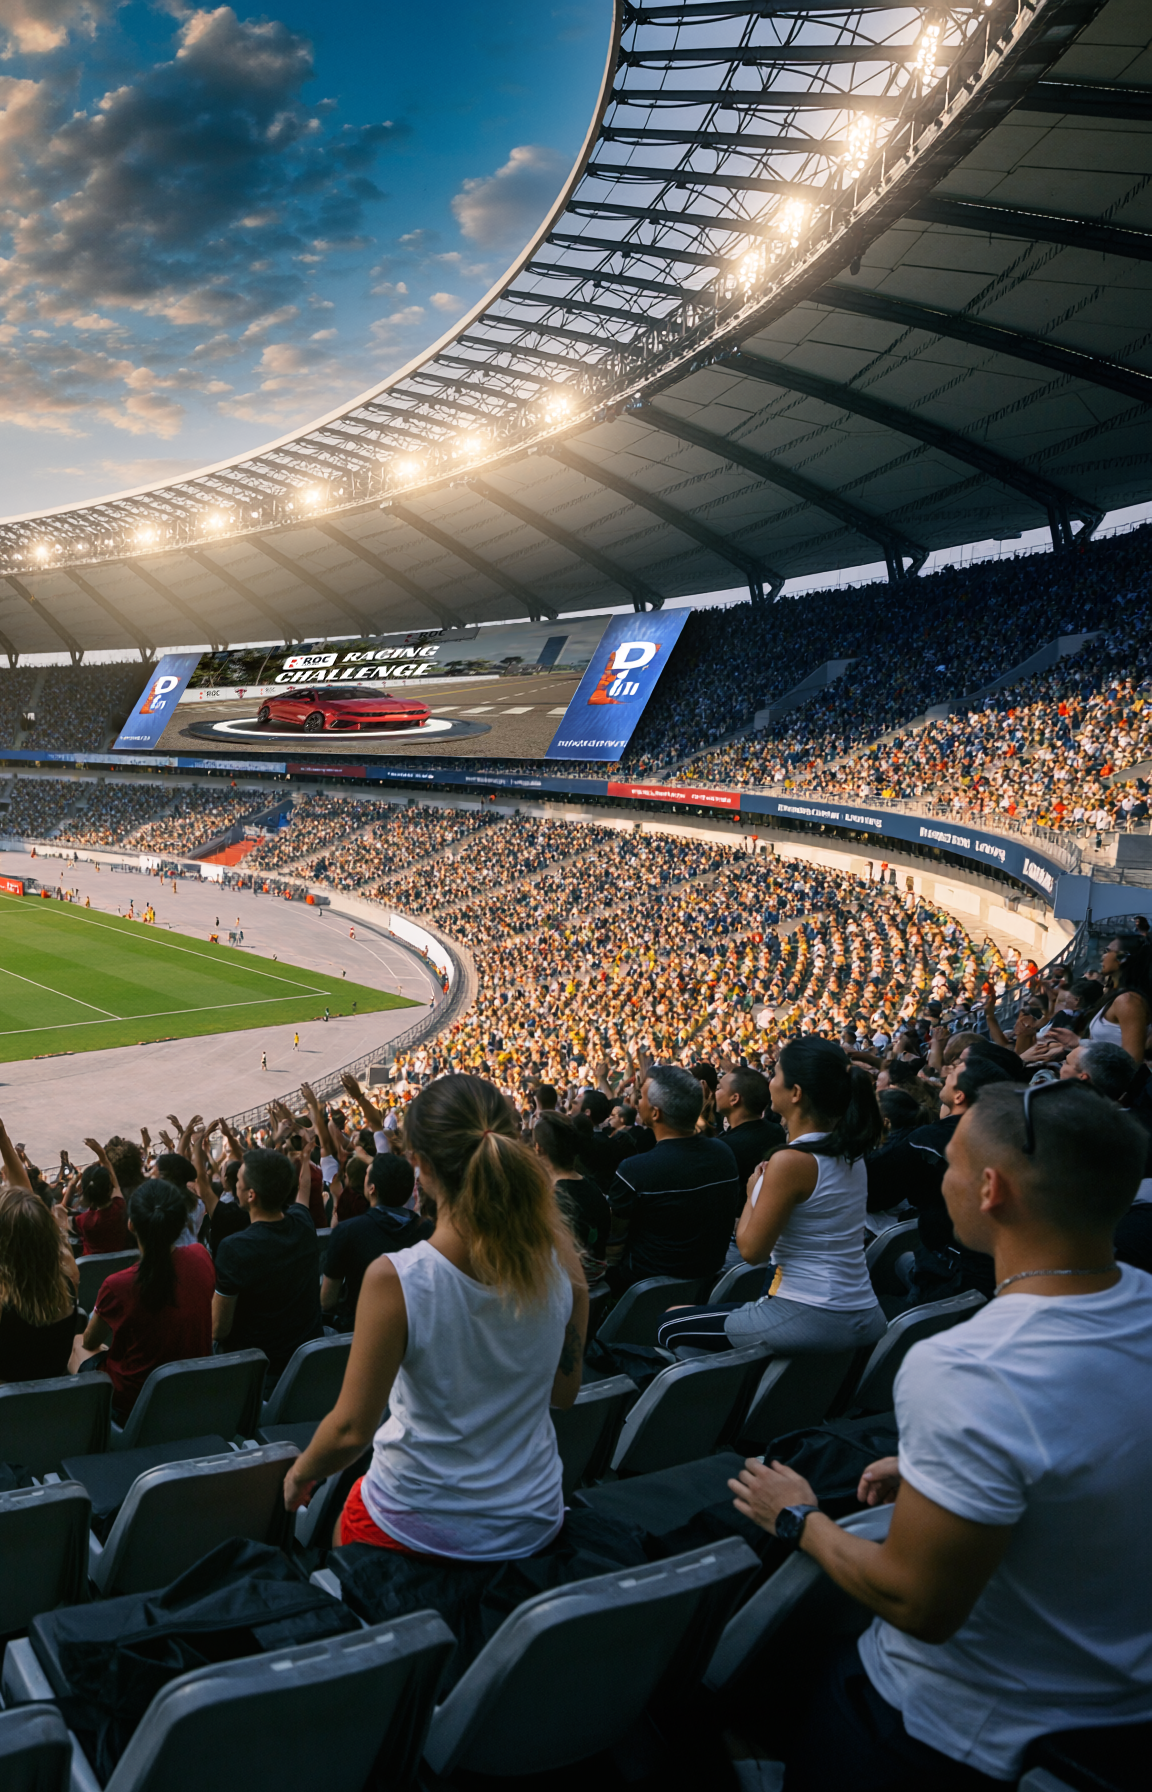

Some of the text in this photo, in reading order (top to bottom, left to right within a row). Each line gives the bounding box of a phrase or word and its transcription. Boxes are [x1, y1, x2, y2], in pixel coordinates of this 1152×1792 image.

[418, 630, 446, 639] ROC
[303, 645, 441, 664] ROC RACING
[274, 662, 438, 684] CHALLENGE
